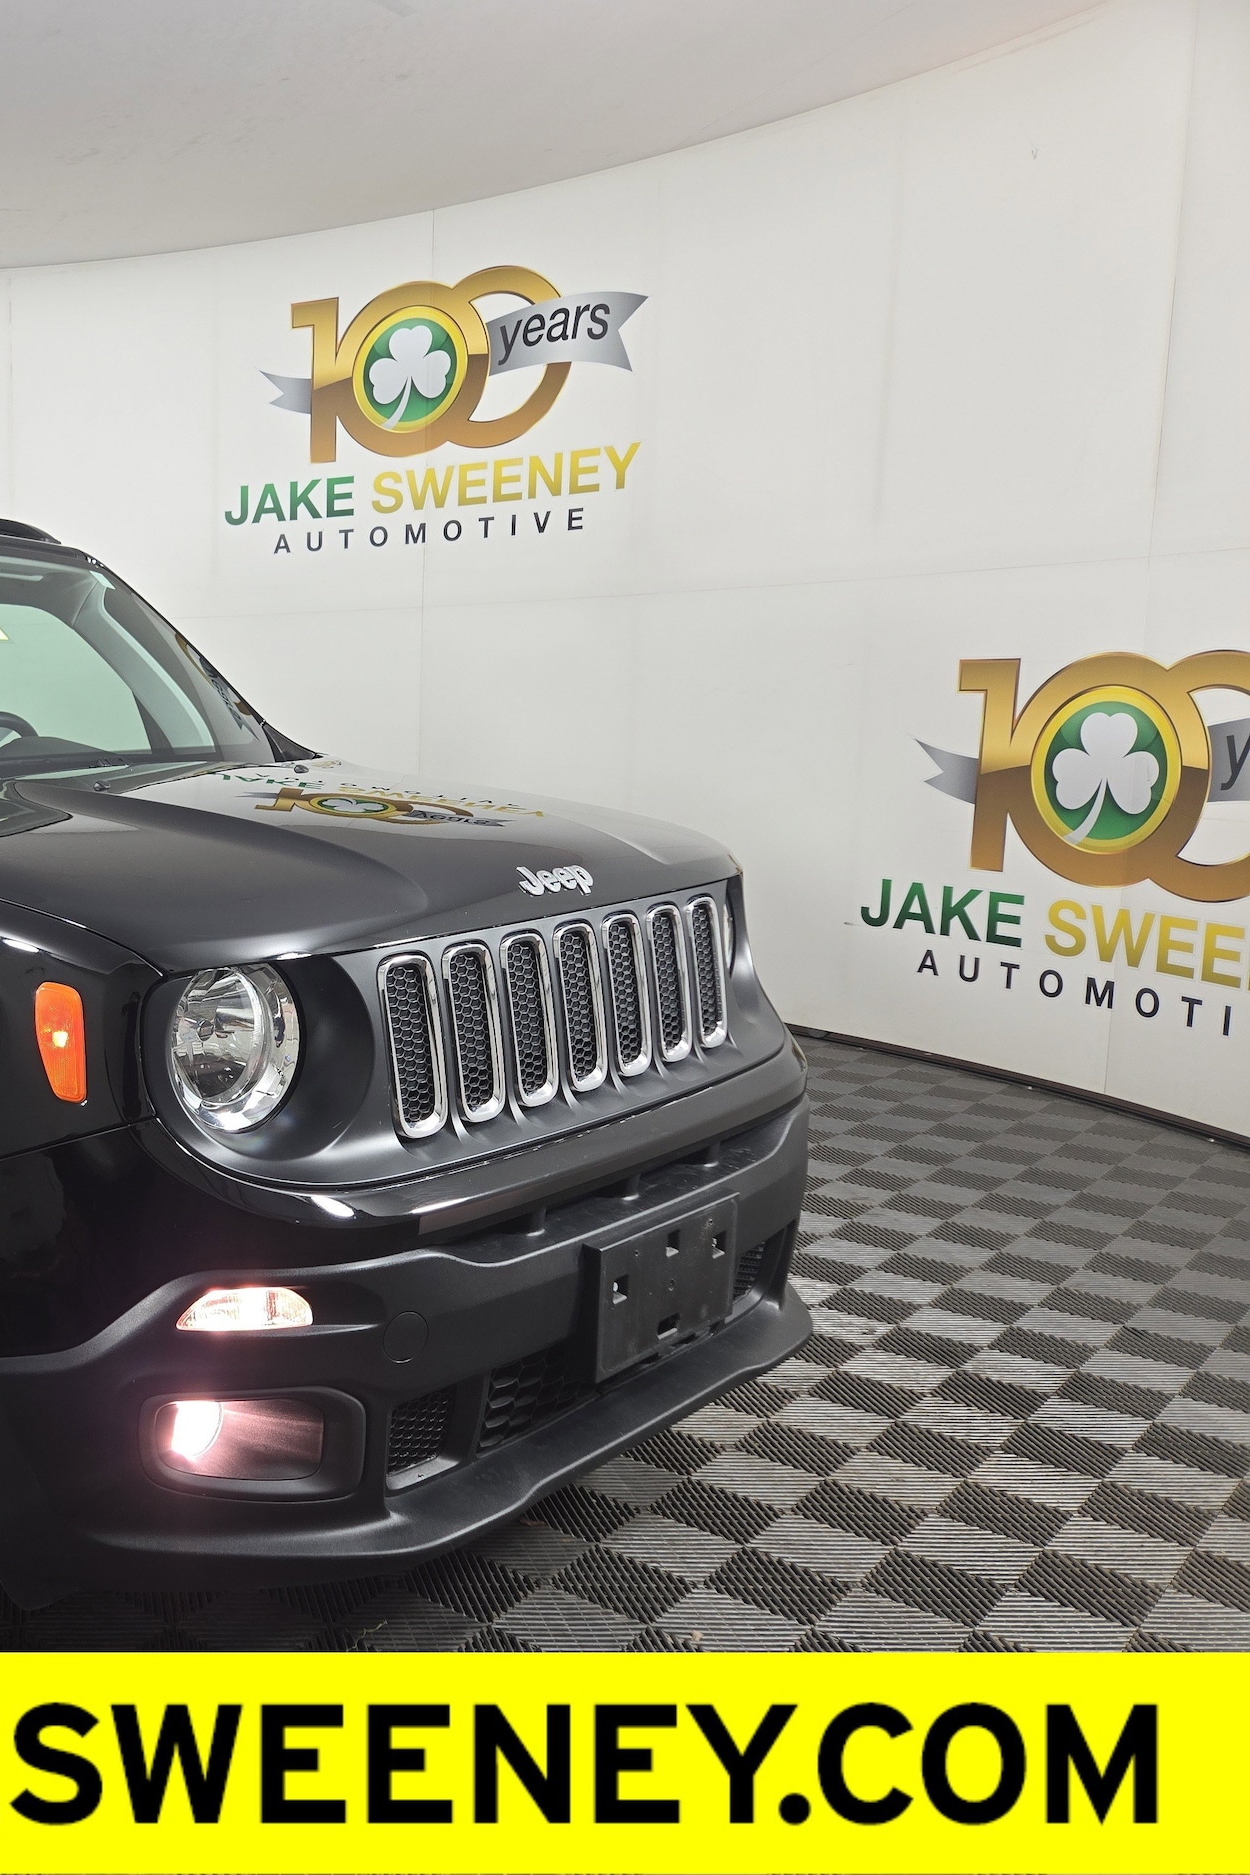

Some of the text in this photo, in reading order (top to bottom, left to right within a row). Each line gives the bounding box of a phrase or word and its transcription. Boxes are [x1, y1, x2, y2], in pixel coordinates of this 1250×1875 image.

[291, 265, 572, 464] 100
[497, 302, 611, 367] years
[224, 441, 642, 527] JAKE SWEENEY
[273, 507, 585, 555] AUTOMOTIVE
[515, 864, 594, 896] Jeep
[860, 878, 1250, 992] JAKE SWEE
